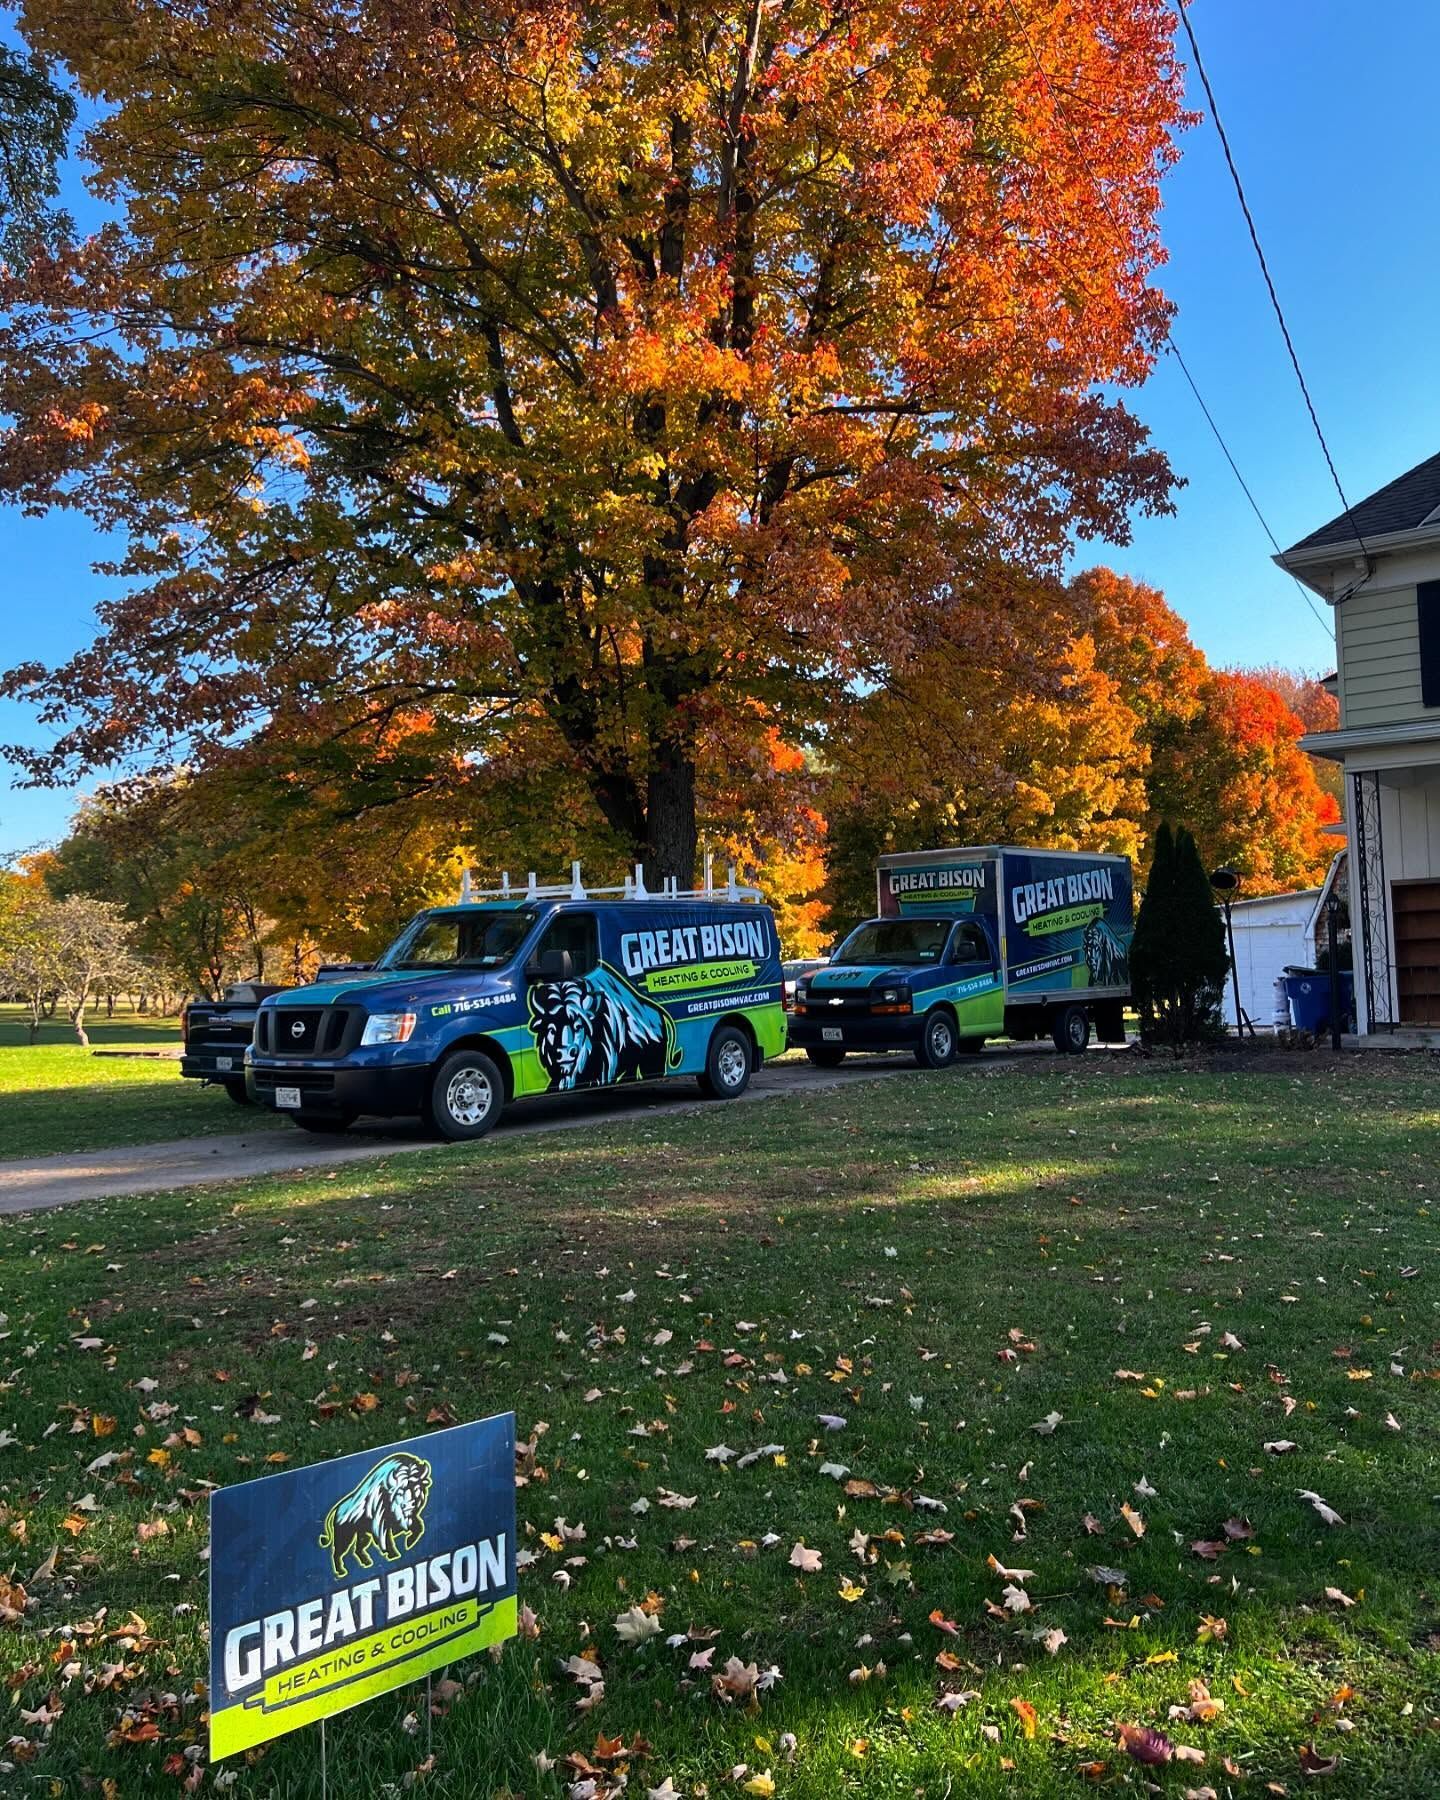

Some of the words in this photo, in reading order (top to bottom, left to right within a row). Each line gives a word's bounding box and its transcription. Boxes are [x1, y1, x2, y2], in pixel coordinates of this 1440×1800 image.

[889, 872, 936, 895] GREAT
[939, 868, 985, 888] BISON
[1012, 878, 1064, 924] GREAT
[1066, 867, 1113, 903] BISON
[1032, 916, 1064, 932] HEATING
[1064, 914, 1070, 923] &
[1071, 907, 1100, 922] COOLING
[621, 927, 698, 977] GREAT
[700, 921, 765, 958] BISON
[652, 971, 698, 987] HEATING
[700, 970, 708, 980] &
[709, 964, 749, 979] COOLING
[431, 1004, 451, 1016] Call
[453, 993, 517, 1012] 716-534-8484
[687, 991, 770, 1014] GREATBISONHVAC.COM
[224, 1578, 381, 1694] GREAT
[387, 1533, 506, 1619] BISON
[277, 1651, 366, 1695] HEATING
[370, 1641, 386, 1658] &
[390, 1607, 468, 1650] COOLING
